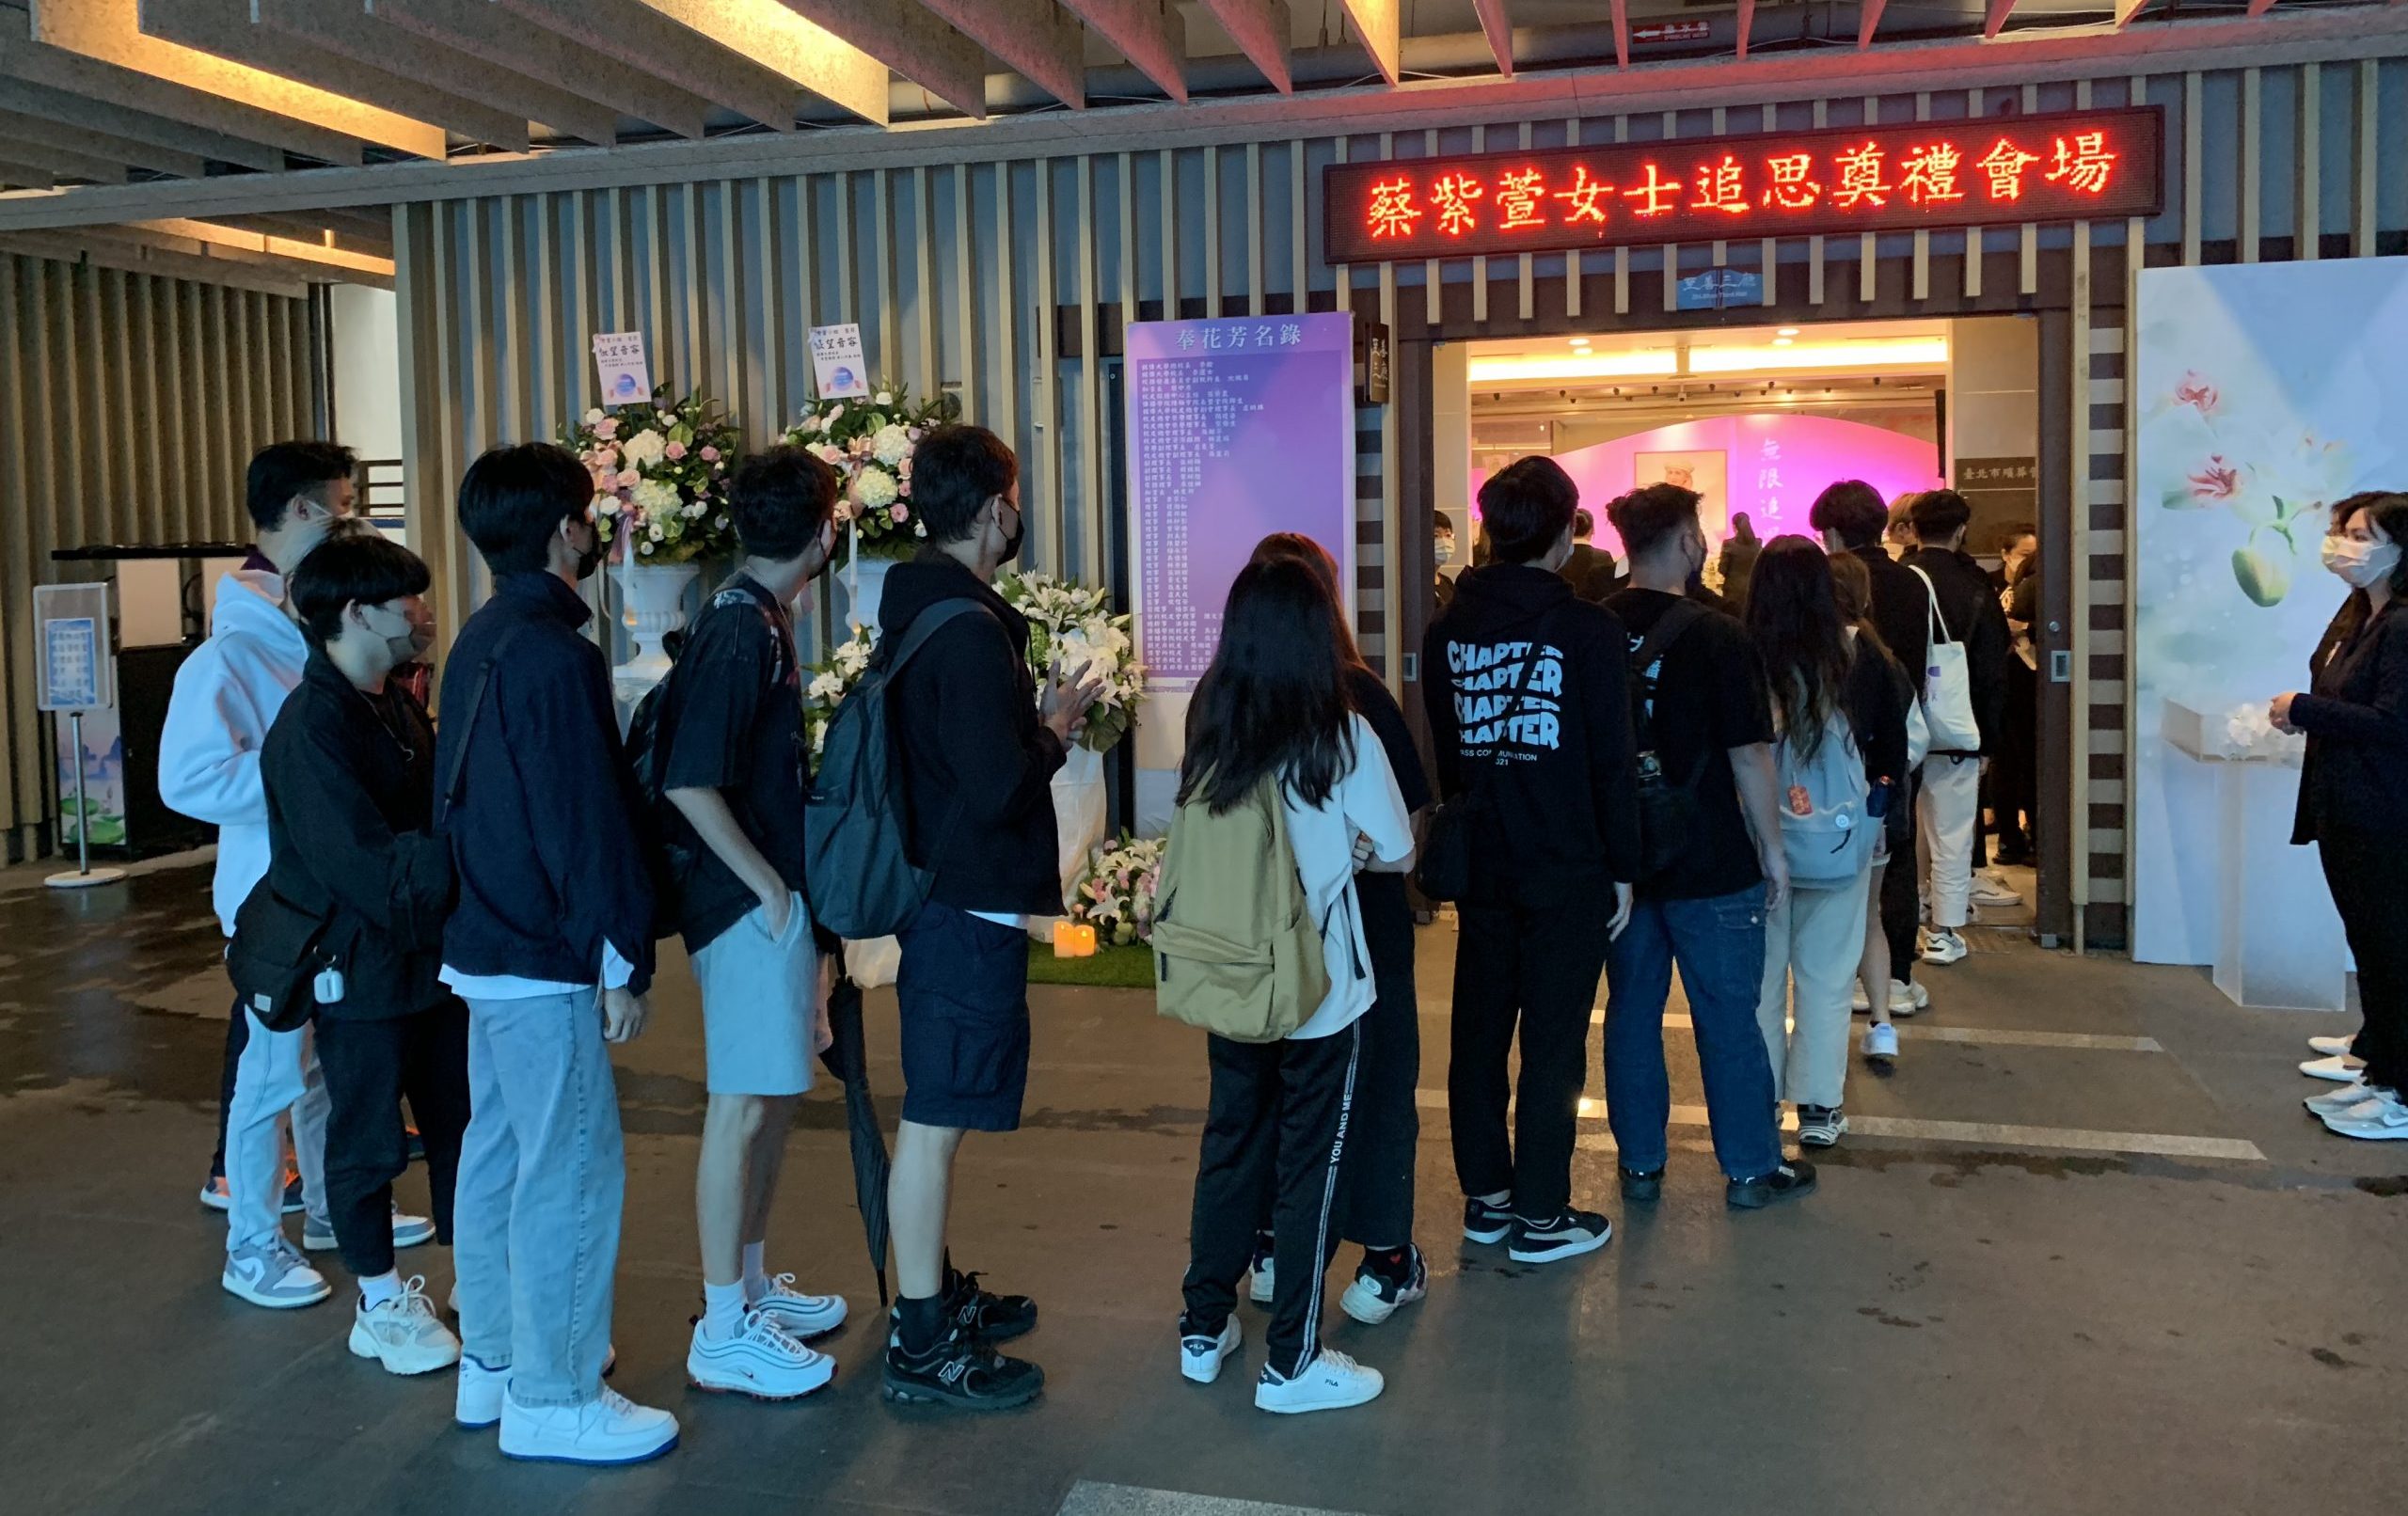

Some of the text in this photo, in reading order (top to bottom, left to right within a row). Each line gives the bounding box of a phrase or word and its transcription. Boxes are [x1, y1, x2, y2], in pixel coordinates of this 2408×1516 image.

[1367, 132, 2116, 239] 蔡紫萱女士追思奠禮會場
[1176, 323, 1303, 351] 奉花芳名錄
[1458, 711, 1560, 750] HAPTER
[1330, 1093, 1353, 1164] YOU AND ME
[938, 1361, 965, 1382] N
[1324, 1378, 1339, 1387] FILA
